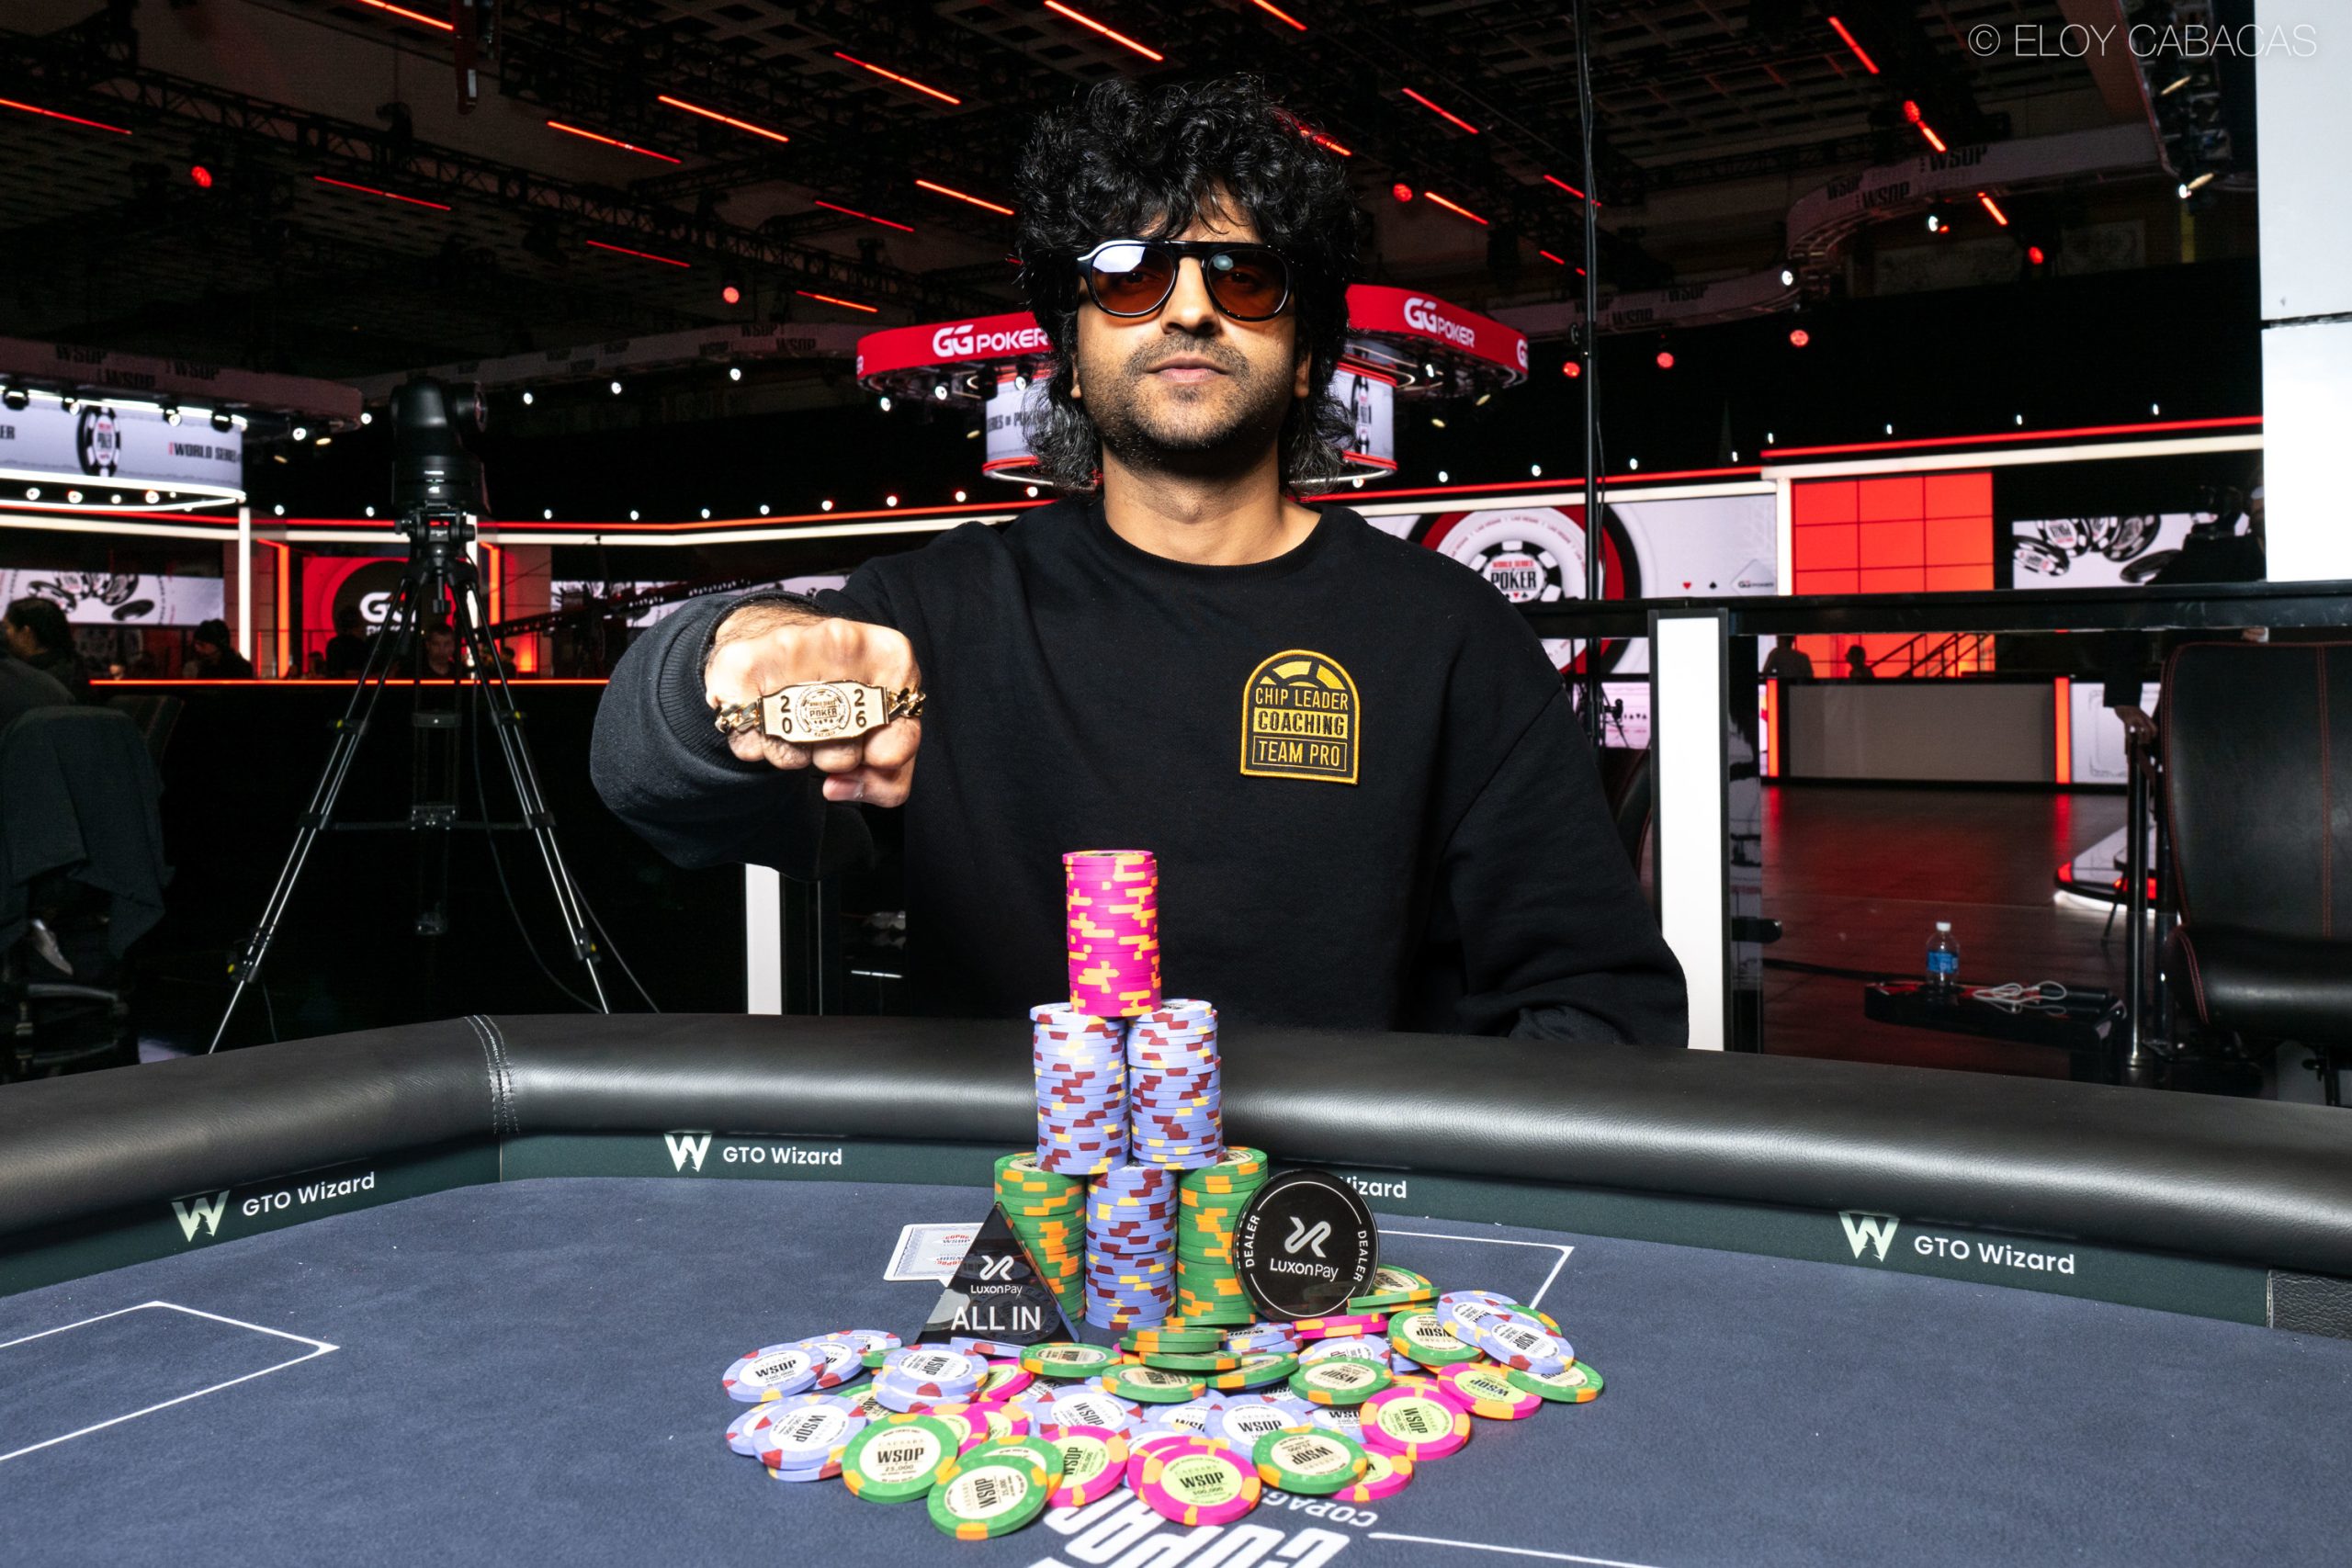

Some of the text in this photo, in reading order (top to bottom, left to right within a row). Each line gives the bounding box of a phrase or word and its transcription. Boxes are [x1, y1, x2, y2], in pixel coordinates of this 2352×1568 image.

[1930, 145, 1987, 171] WSOP
[1863, 182, 1909, 208] WSOP
[175, 443, 213, 459] WORLD
[1490, 570, 1537, 589] POKER
[1255, 687, 1349, 711] CHIP LEADER
[809, 707, 838, 717] POKER
[1258, 710, 1345, 736] COACHING
[1259, 740, 1340, 767] TEAM PRO
[723, 1145, 766, 1163] GTO
[770, 1145, 842, 1166] Wizard
[243, 1191, 291, 1217] GTO
[297, 1171, 376, 1204] Wizard
[1340, 1176, 1408, 1199] izard
[1245, 1214, 1261, 1269] DEALER
[1352, 1230, 1369, 1282] DEALER
[1914, 1235, 1971, 1259] GTO
[1977, 1242, 2075, 1275] Wizard
[950, 1305, 1041, 1331] ALL IN
[1513, 1333, 1540, 1350] WSOP
[755, 1359, 797, 1378] WSOP
[921, 1356, 950, 1376] WSOP
[1470, 1380, 1510, 1396] WSOP
[1073, 1402, 1105, 1426] WSOP
[1403, 1407, 1428, 1435] WSOP
[792, 1415, 828, 1443] WSOP
[1238, 1420, 1283, 1433] WSOP
[877, 1448, 924, 1464] WSOP
[1063, 1447, 1084, 1476] WSOP
[1291, 1446, 1334, 1465] WSOP
[1179, 1472, 1225, 1488] WSOP
[974, 1477, 998, 1509] WSOP
[1261, 1487, 1378, 1528] COPAG
